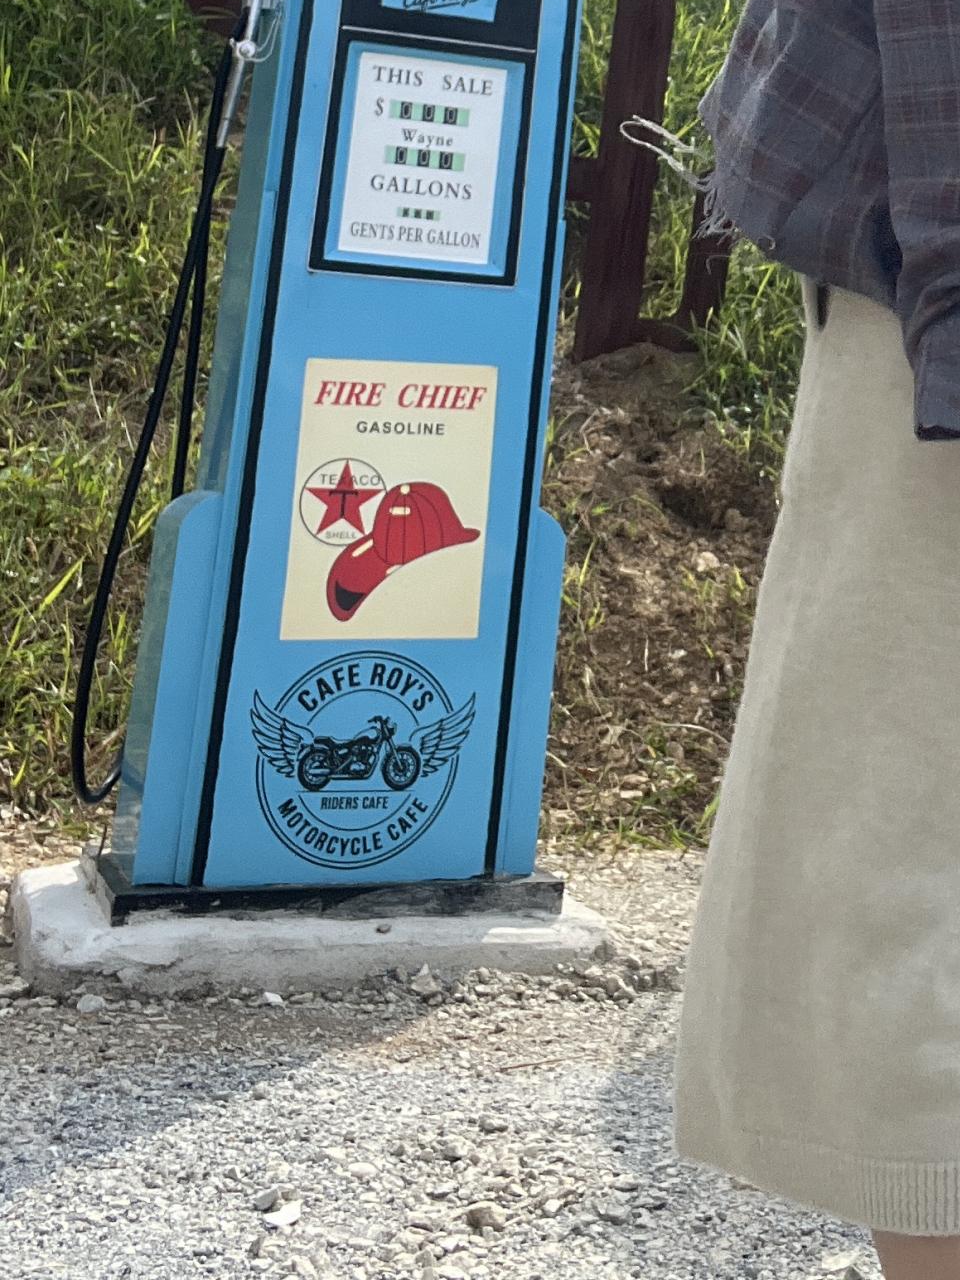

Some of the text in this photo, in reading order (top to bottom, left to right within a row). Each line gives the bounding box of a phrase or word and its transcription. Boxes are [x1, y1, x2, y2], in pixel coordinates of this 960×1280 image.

[372, 65, 494, 96] THIS SALE
[402, 128, 453, 147] Wayne
[370, 174, 473, 200] GALLONS
[398, 226, 423, 242] PER
[427, 228, 481, 249] GALLON
[314, 380, 487, 410] FIRE CHIEF
[356, 420, 446, 436] GASOLINE
[320, 473, 381, 487] TEACO
[298, 662, 434, 712] CAFE ROY'S
[320, 796, 389, 810] RIDERS CAFE
[277, 797, 428, 857] MOTORCYCLE CAFE
